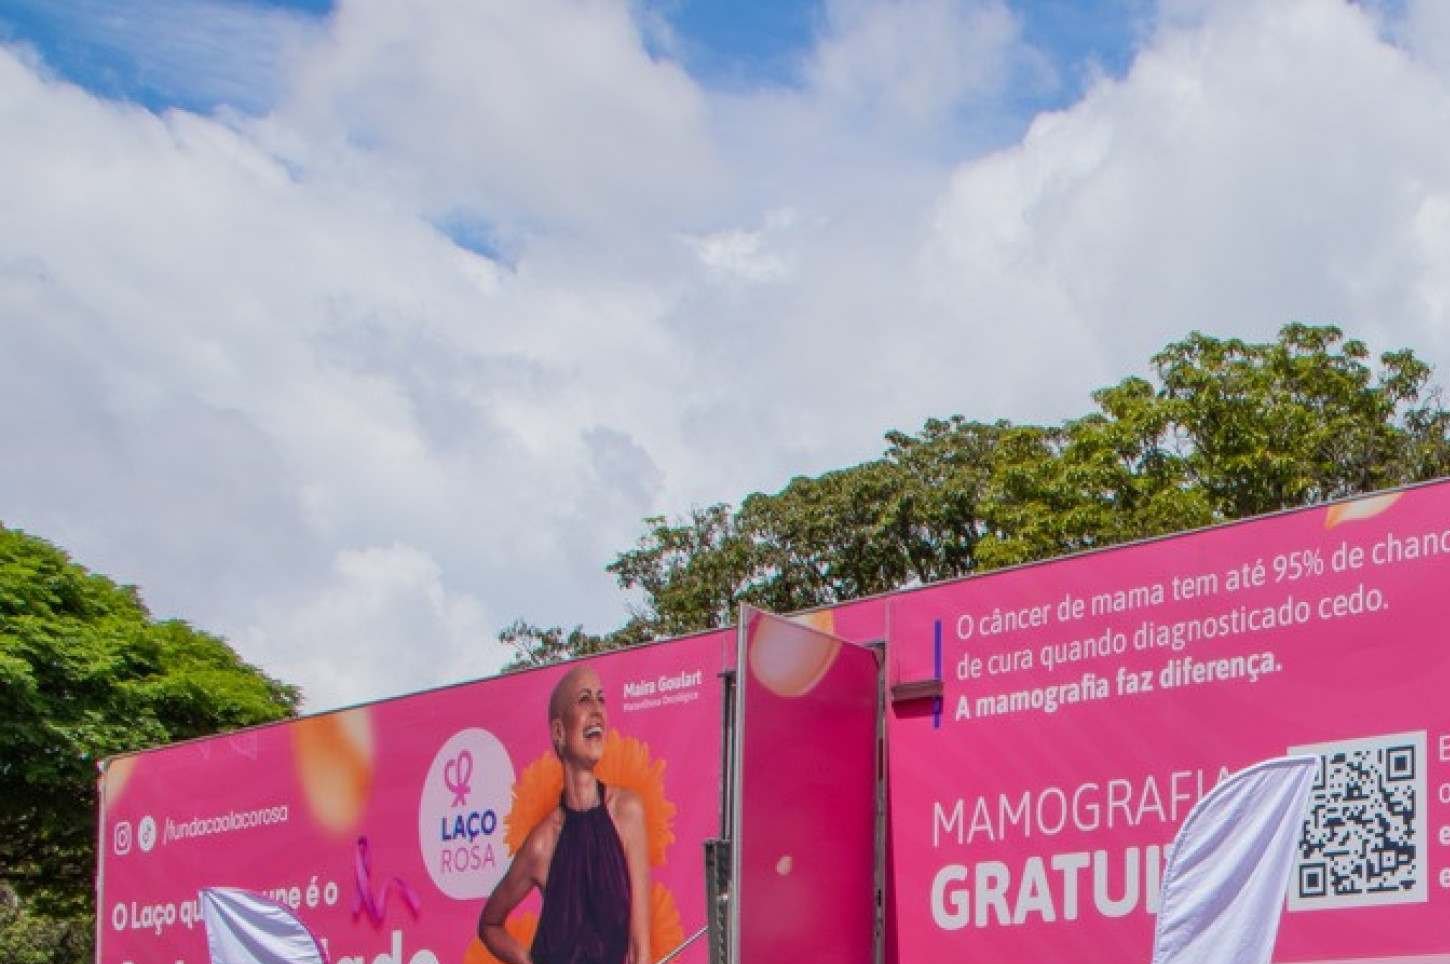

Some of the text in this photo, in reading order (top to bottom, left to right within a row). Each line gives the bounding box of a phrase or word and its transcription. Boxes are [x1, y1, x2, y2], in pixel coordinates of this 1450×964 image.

[956, 615, 974, 640] O
[980, 604, 1051, 635] câncer
[1057, 594, 1084, 622] de
[1092, 584, 1164, 616] mama
[1172, 573, 1218, 601] tem
[1226, 558, 1266, 592] até
[1273, 548, 1324, 582] 95%
[1332, 542, 1364, 572] de
[957, 583, 1389, 681] de cura quando diagnosticado cedo.
[955, 651, 1283, 721] A mamografia faz diferença.
[440, 808, 497, 842] LAÇO
[440, 844, 495, 873] ROSA
[112, 902, 128, 931] O
[131, 902, 176, 935] Laço
[180, 900, 204, 929] qu
[306, 876, 320, 907] é
[324, 882, 338, 906] o
[930, 843, 1172, 931] GRATUI
